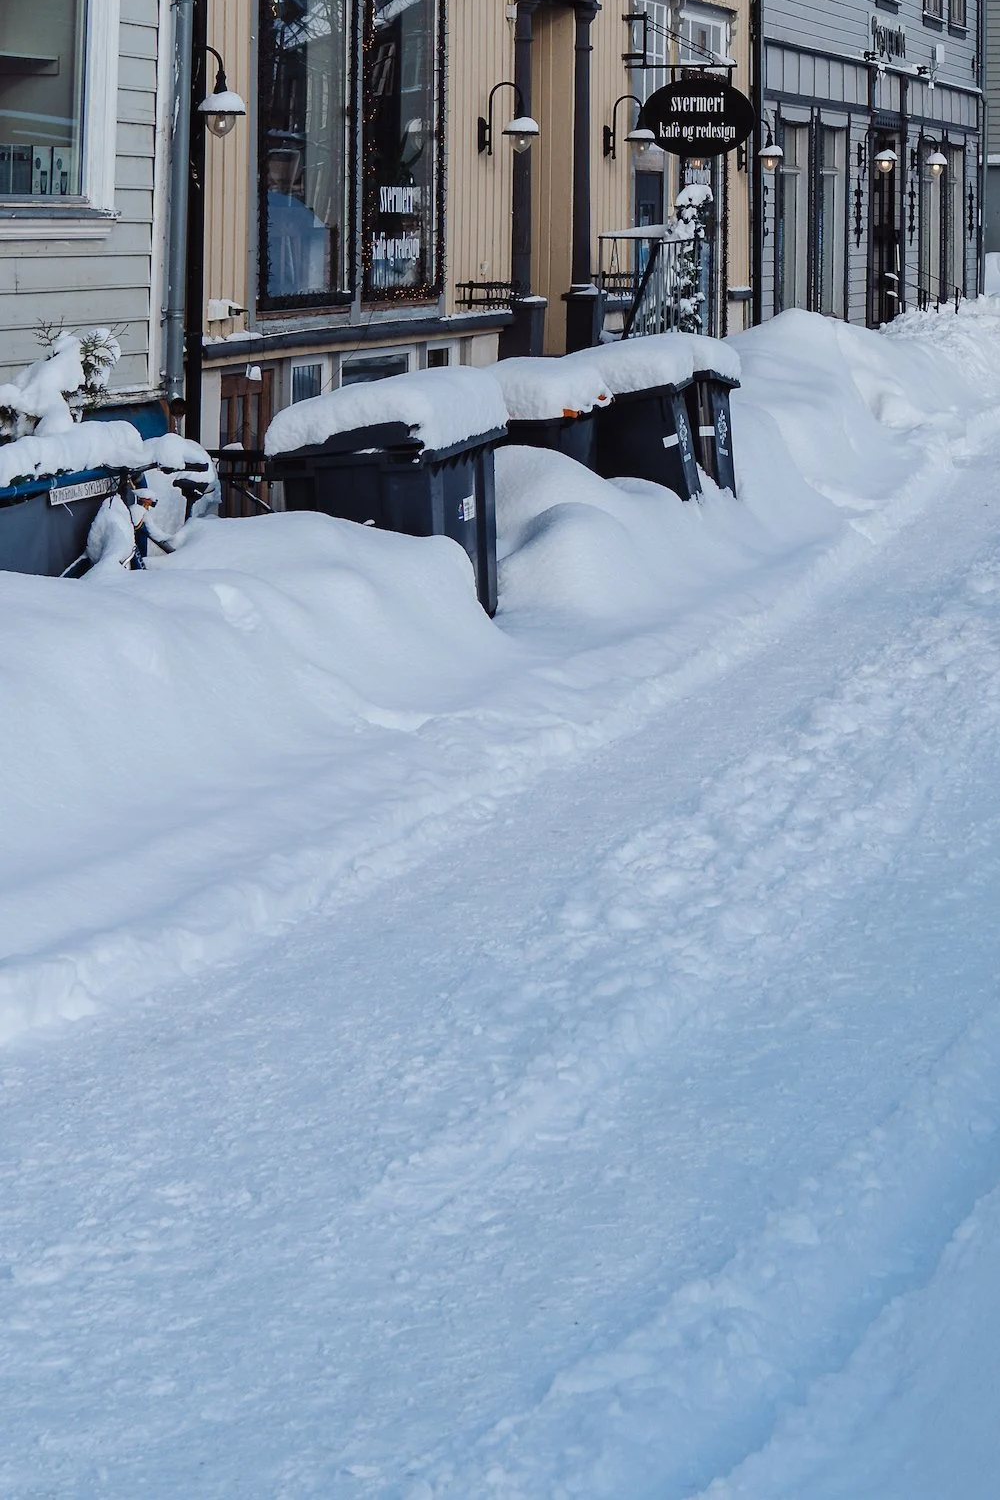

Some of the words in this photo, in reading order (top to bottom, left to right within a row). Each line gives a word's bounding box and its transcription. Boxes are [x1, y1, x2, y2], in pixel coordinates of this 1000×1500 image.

[670, 92, 725, 113] svermeri
[682, 125, 694, 142] og
[695, 121, 736, 142] redesign
